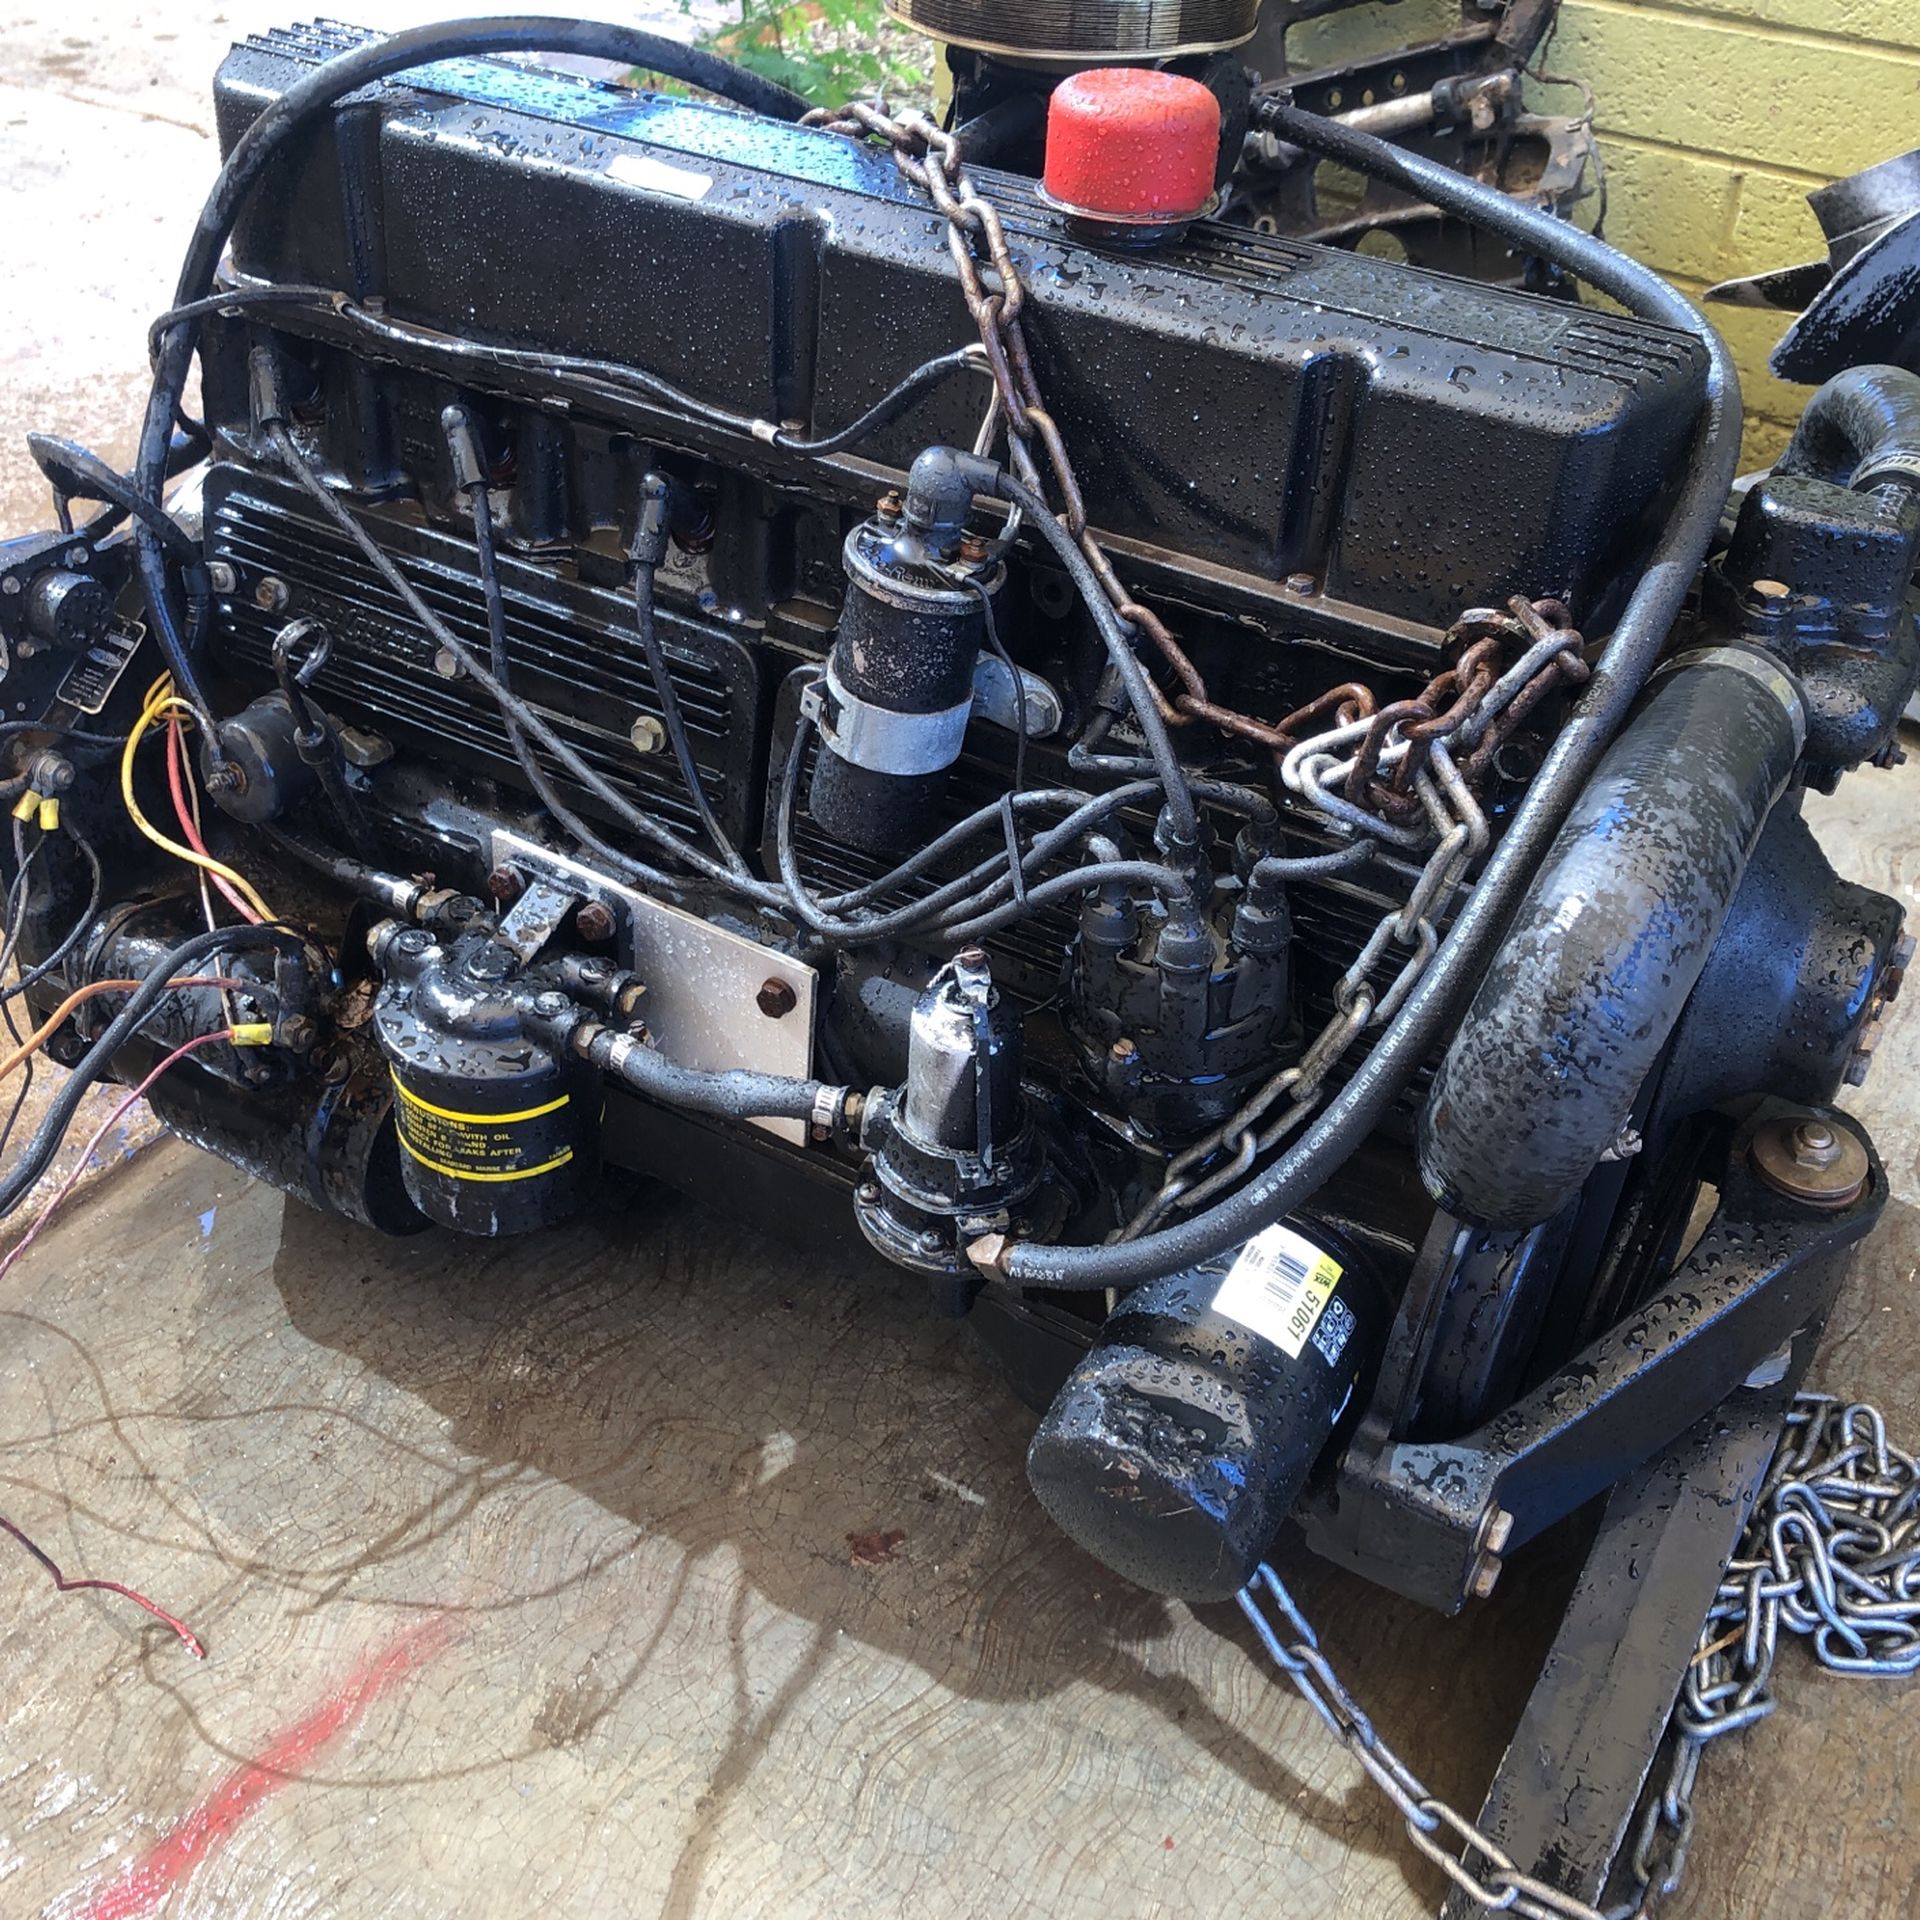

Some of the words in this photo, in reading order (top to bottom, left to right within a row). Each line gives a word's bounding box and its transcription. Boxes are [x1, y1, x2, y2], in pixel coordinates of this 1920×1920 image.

[1331, 1108, 1347, 1126] SAE
[1371, 1057, 1387, 1074] EPA
[1381, 1014, 1414, 1057] COMPLIANT
[1287, 1290, 1321, 1341] 51061
